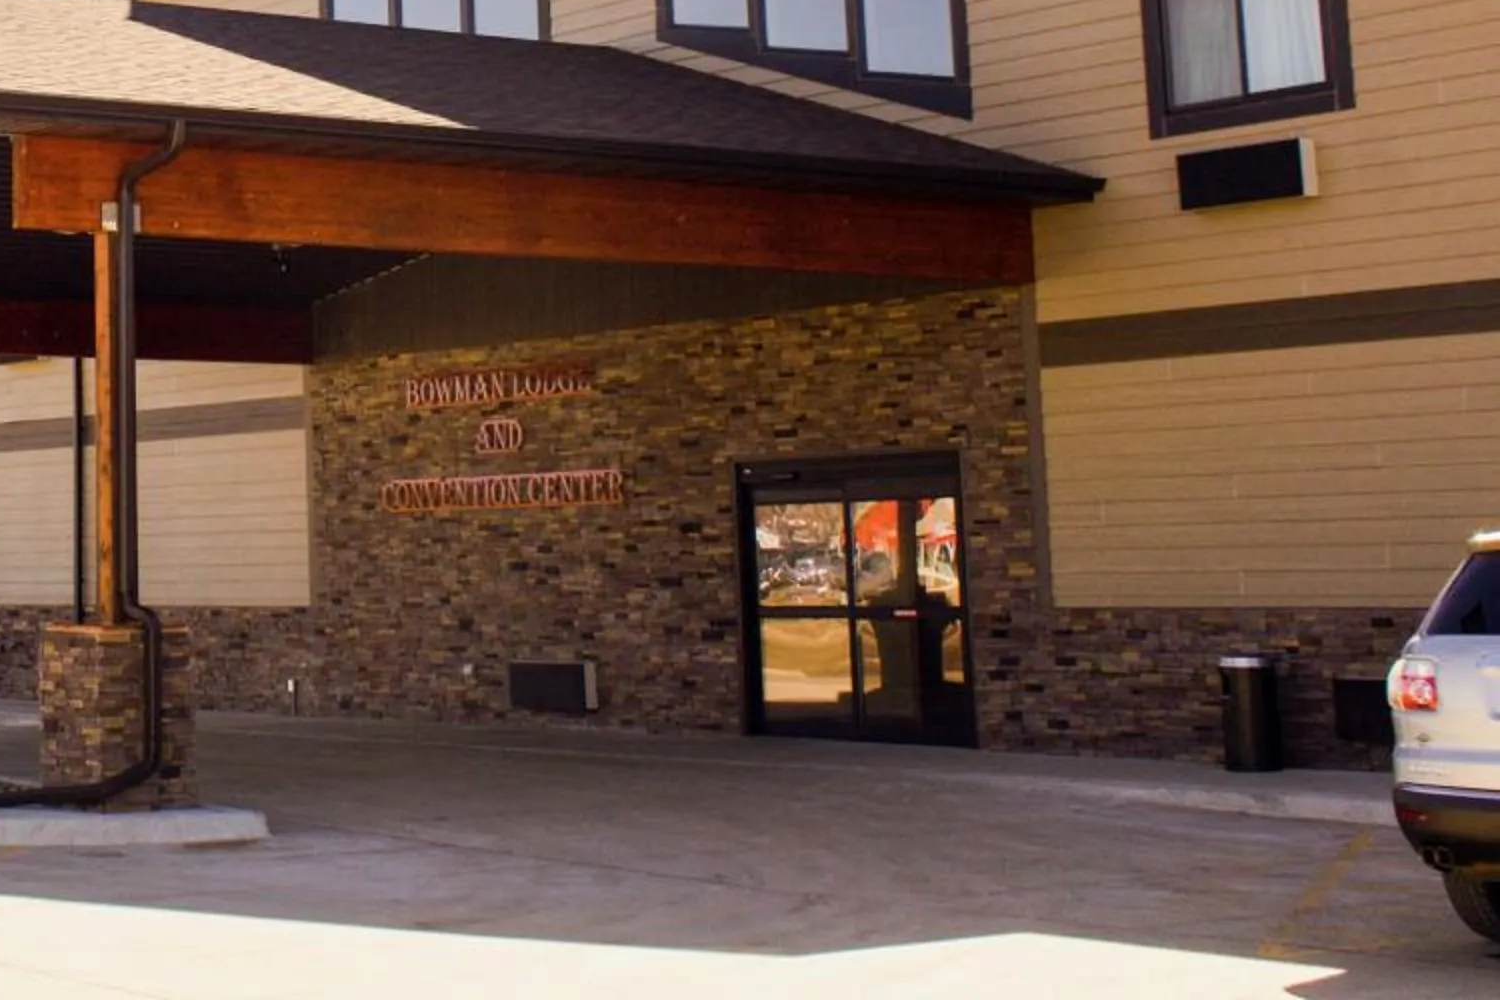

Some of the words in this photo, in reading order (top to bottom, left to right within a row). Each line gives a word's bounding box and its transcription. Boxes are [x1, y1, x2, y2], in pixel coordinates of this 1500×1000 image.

[403, 370, 507, 408] BOWMAN
[475, 418, 524, 454] AND
[380, 474, 521, 513] CONVENTION
[526, 467, 624, 508] CENTER
